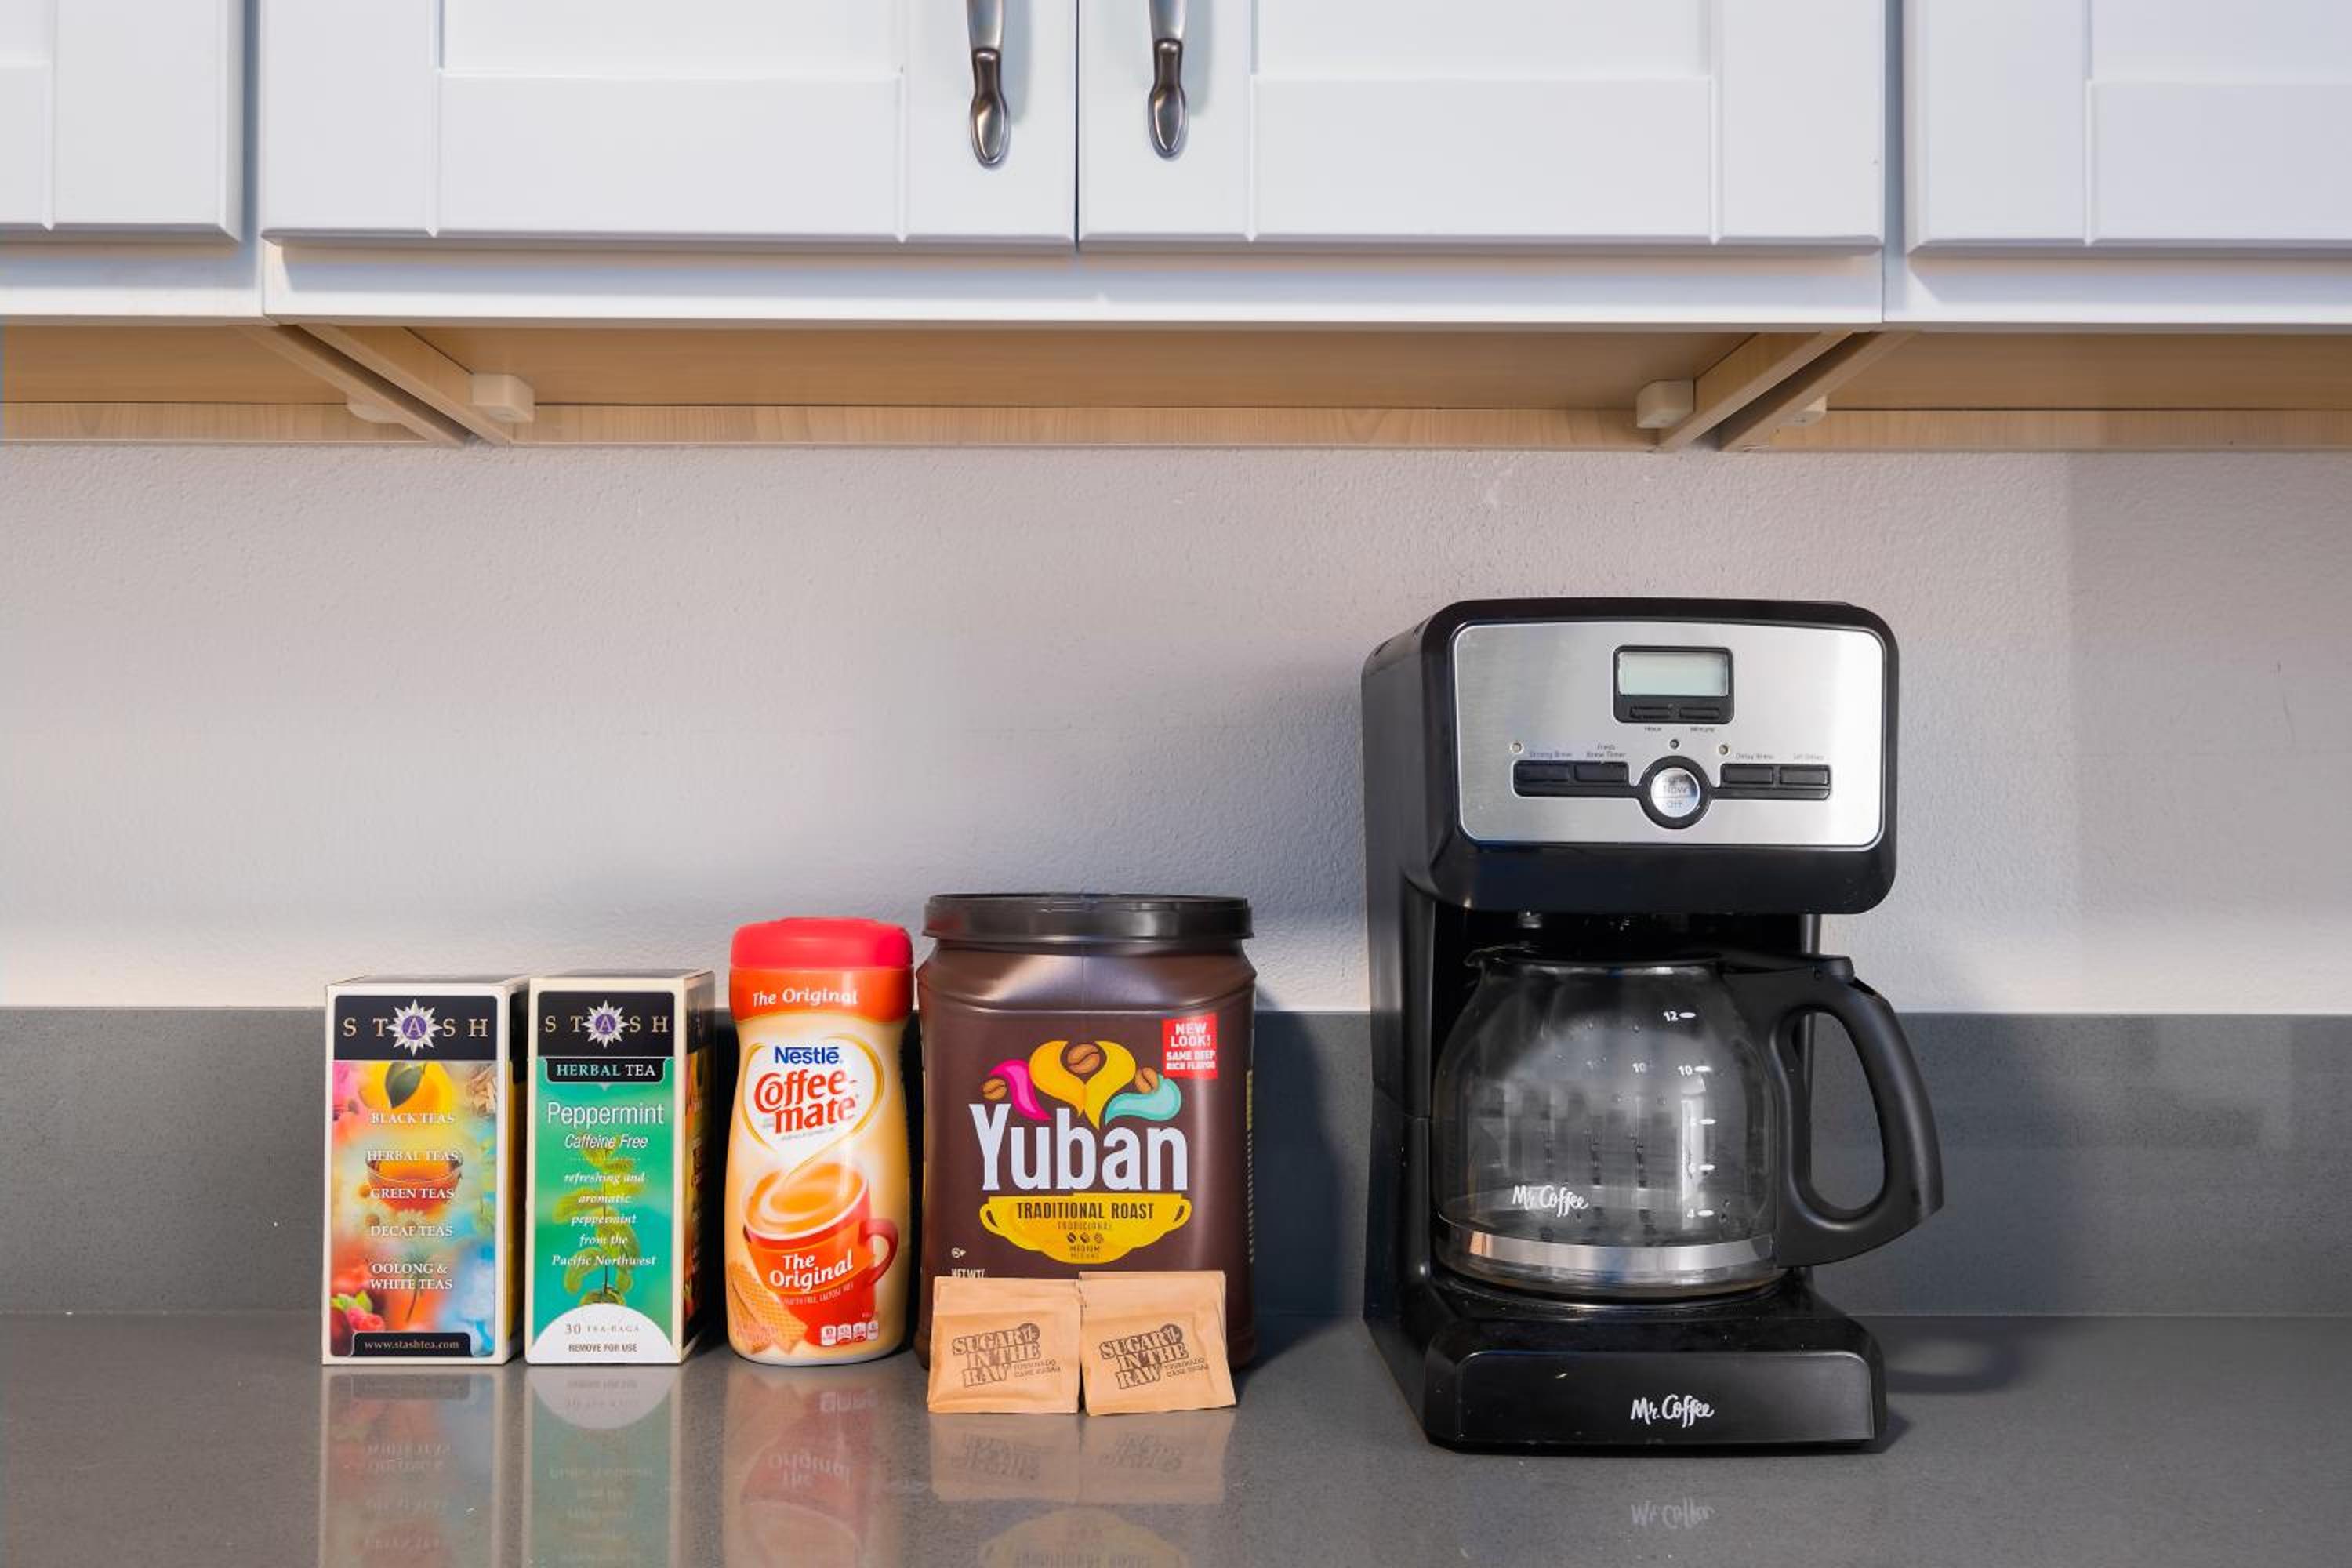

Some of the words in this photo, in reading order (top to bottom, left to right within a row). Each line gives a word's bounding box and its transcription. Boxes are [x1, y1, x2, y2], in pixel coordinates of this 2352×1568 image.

[753, 991, 777, 1007] The
[782, 987, 858, 1007] Original
[1664, 1011, 1679, 1022] 12
[343, 1018, 488, 1038] STASH
[545, 1015, 669, 1033] STASH
[1175, 1022, 1207, 1036] NEW
[1171, 1035, 1211, 1048] LOOK!
[1166, 1051, 1192, 1062] SAME
[556, 1065, 621, 1076] HERBAL
[626, 1064, 656, 1076] TEA
[1678, 1065, 1692, 1076] 10
[371, 1112, 415, 1124] BLACK
[420, 1112, 455, 1123] TEAS
[548, 1102, 665, 1129] Peppermint
[774, 1096, 856, 1134] mate
[564, 1134, 615, 1149] Caffeine
[619, 1134, 648, 1149] Free
[969, 1103, 1189, 1191] Yuban
[367, 1151, 419, 1162] HERBAL
[425, 1150, 459, 1162] TEAS
[564, 1172, 620, 1185] refreshing
[624, 1172, 646, 1183] and
[371, 1188, 416, 1199] GREEN
[421, 1188, 455, 1199] TEAS
[578, 1194, 633, 1204] aromatic
[1538, 1185, 1589, 1217] Coffee
[1016, 1202, 1105, 1219] TRADITIONAL
[1111, 1202, 1155, 1219] ROAST
[571, 1214, 637, 1227] peppermint
[371, 1225, 415, 1236] DECAF
[419, 1225, 452, 1236] TEAS
[579, 1234, 607, 1247] from
[610, 1234, 628, 1245] the
[552, 1254, 590, 1268] Pacific
[595, 1254, 656, 1267] Northwest
[782, 1253, 815, 1271] The
[372, 1263, 434, 1275] OOLONG
[437, 1264, 448, 1274] &
[769, 1247, 855, 1294] Original
[370, 1279, 415, 1290] WHITE
[419, 1279, 452, 1290] TEAS
[565, 1323, 582, 1334] 30
[365, 1340, 459, 1350] www.stashtea.com
[568, 1343, 601, 1353] REMOVE
[604, 1343, 619, 1352] FOR
[622, 1343, 637, 1352] USE
[952, 1329, 1025, 1356] SUGAR
[1099, 1331, 1170, 1360] SUGAR
[967, 1352, 991, 1369] IN
[995, 1342, 1042, 1365] THE
[1116, 1353, 1141, 1371] IN
[1144, 1342, 1189, 1365] THE
[963, 1363, 1011, 1387] RAW
[1115, 1365, 1161, 1389] RAW
[1630, 1396, 1660, 1425] Mr.
[1661, 1393, 1715, 1428] Coffee
